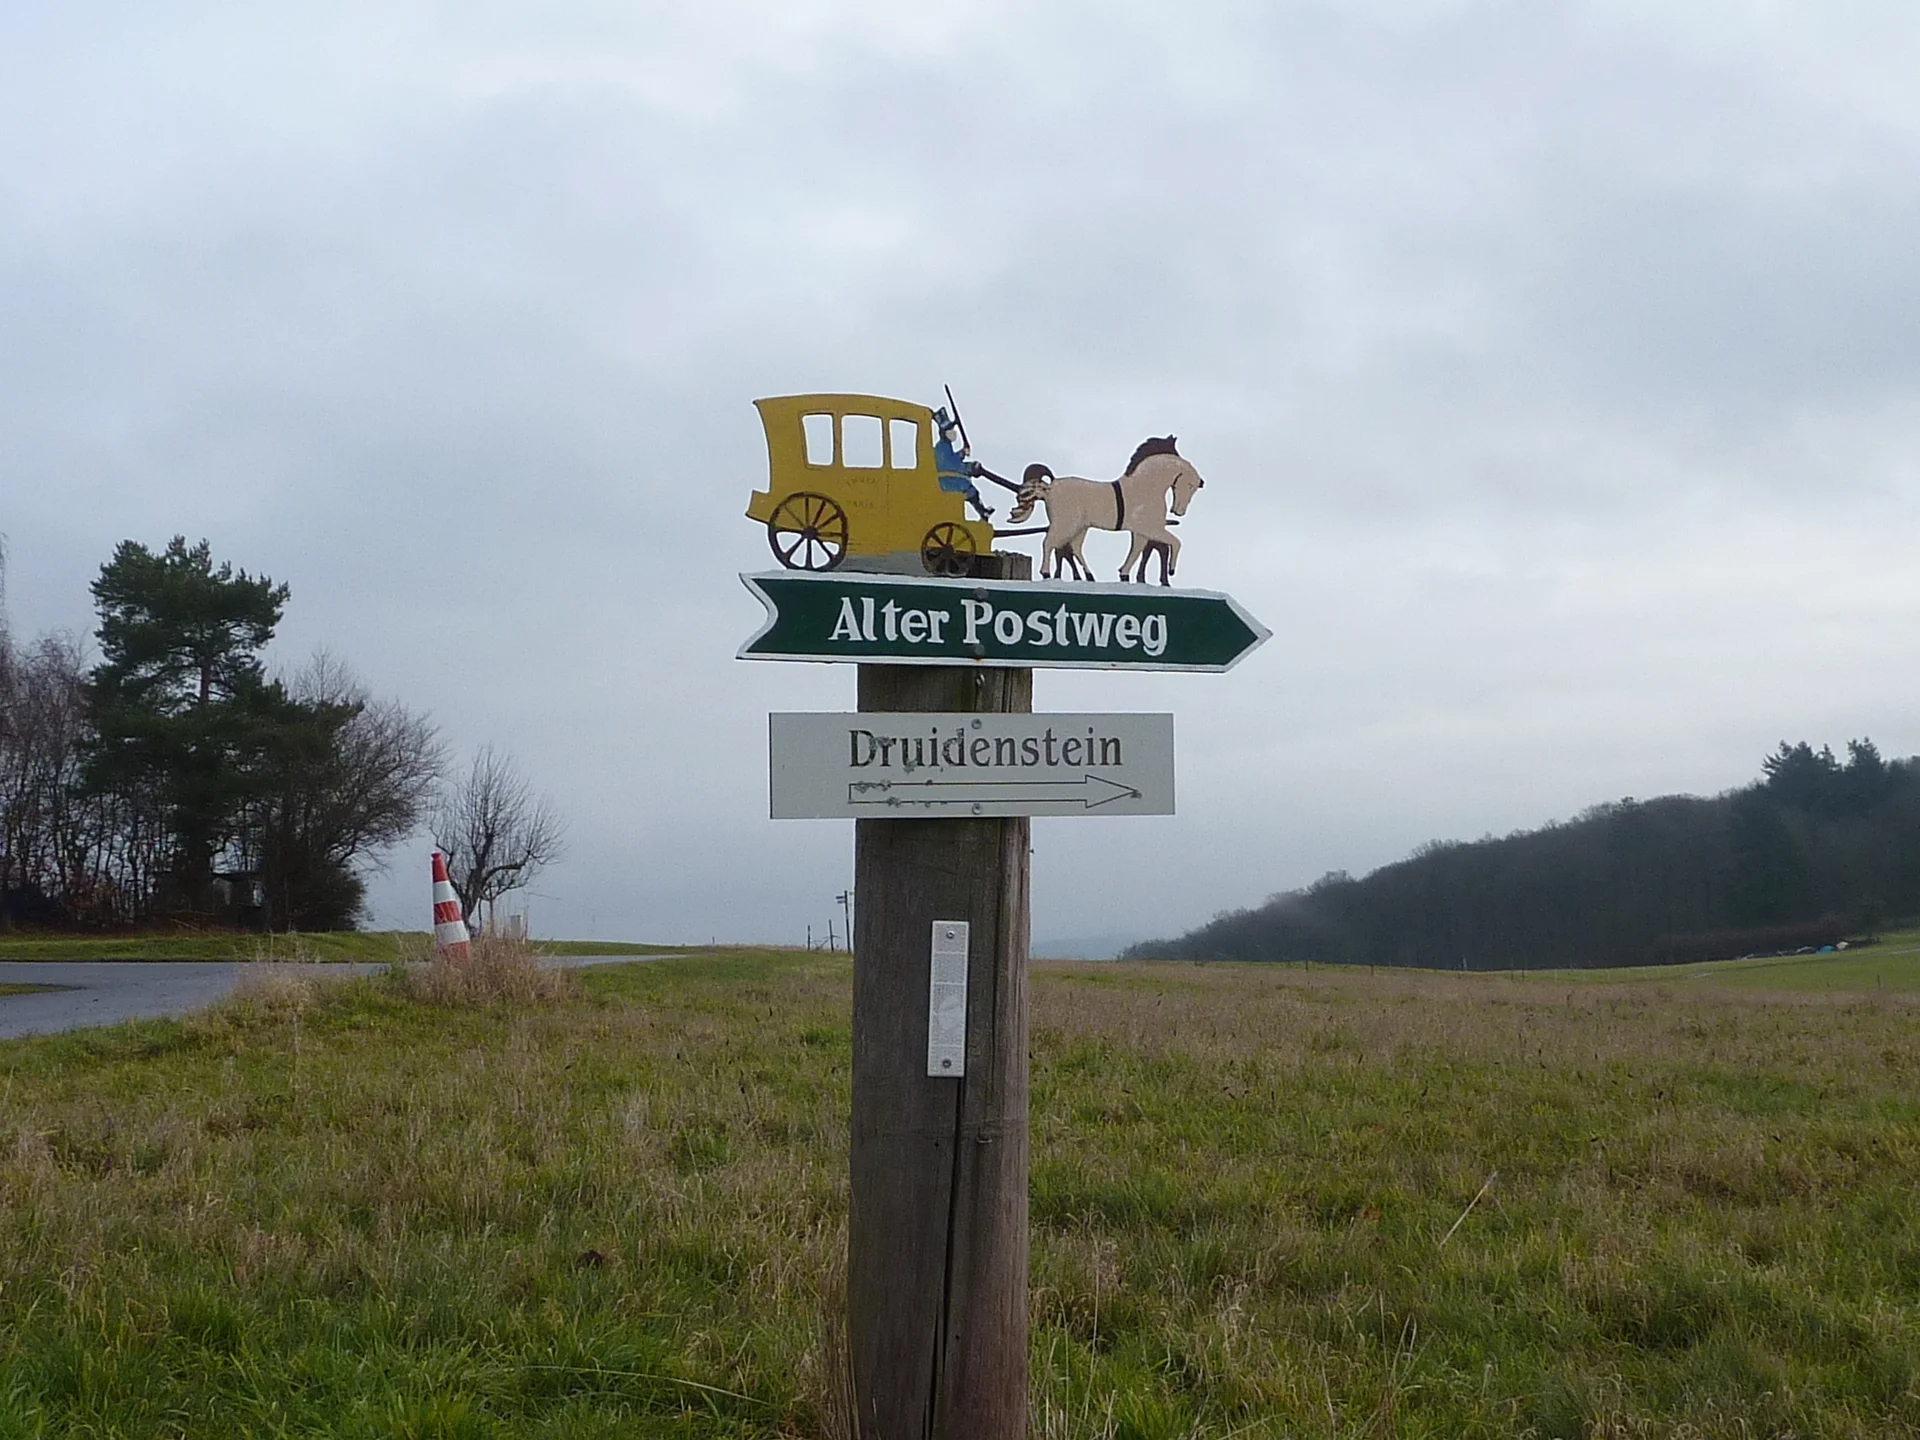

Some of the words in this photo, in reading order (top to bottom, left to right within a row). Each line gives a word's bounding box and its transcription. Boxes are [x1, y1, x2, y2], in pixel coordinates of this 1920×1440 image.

[828, 597, 949, 643] Alter
[961, 599, 1168, 656] Postweg
[849, 726, 1123, 767] Druidenstein
